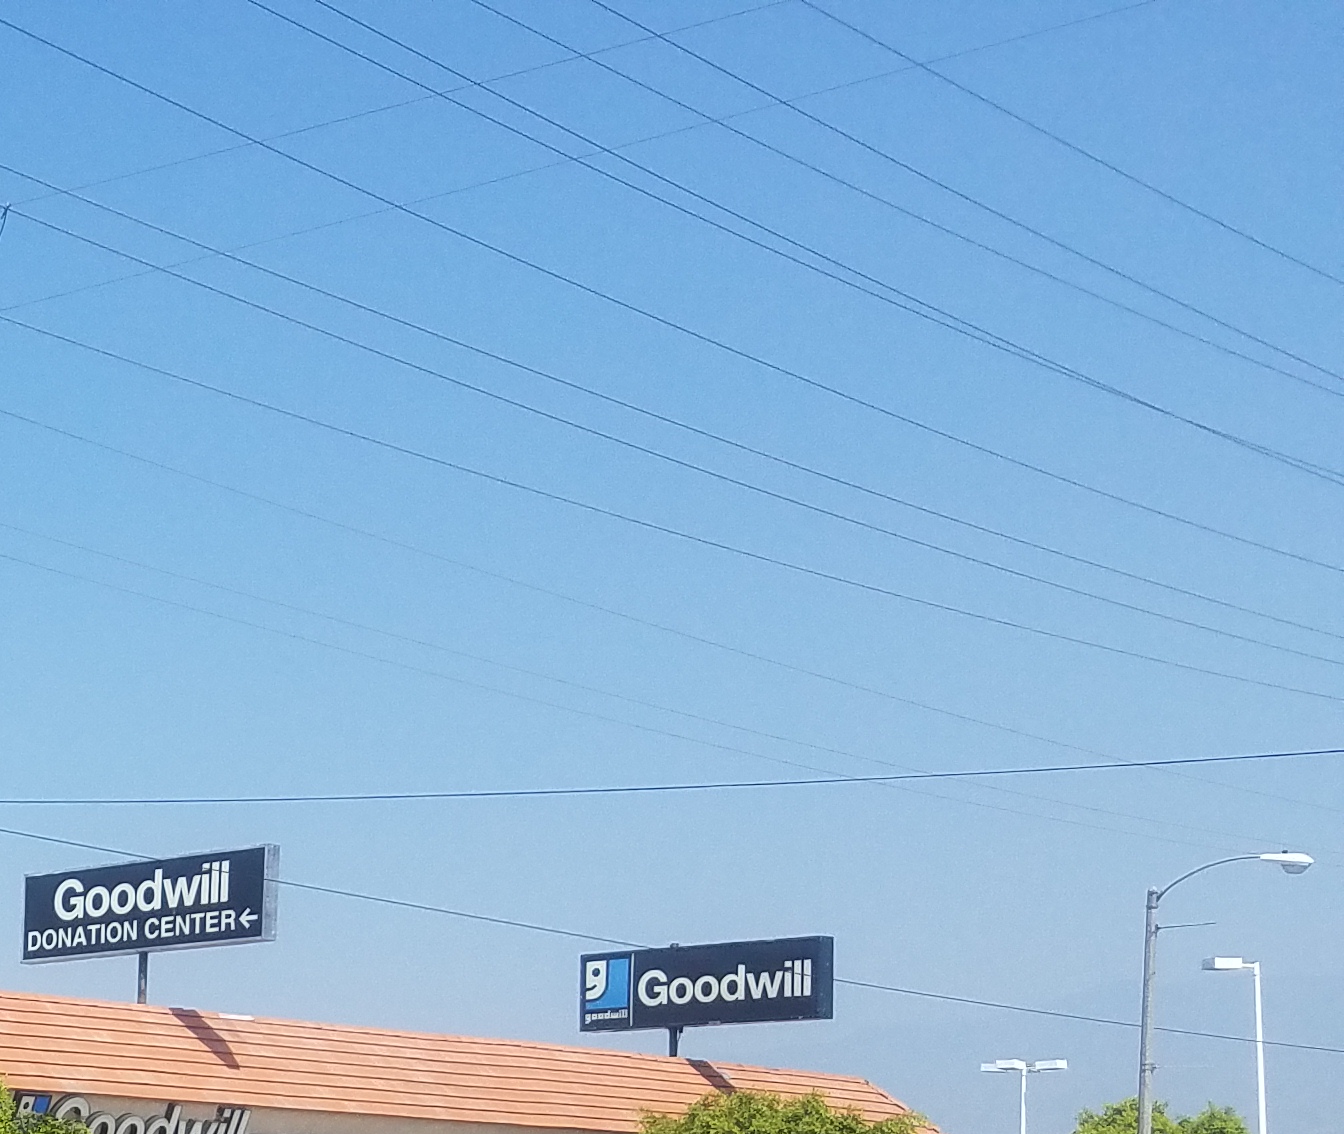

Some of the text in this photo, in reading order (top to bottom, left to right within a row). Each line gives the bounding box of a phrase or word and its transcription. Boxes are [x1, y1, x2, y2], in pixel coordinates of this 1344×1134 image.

[53, 859, 230, 921] Goodwill
[27, 908, 237, 952] DONATION CENTER
[637, 958, 812, 1007] Goodwill
[584, 1008, 628, 1025] goodwill
